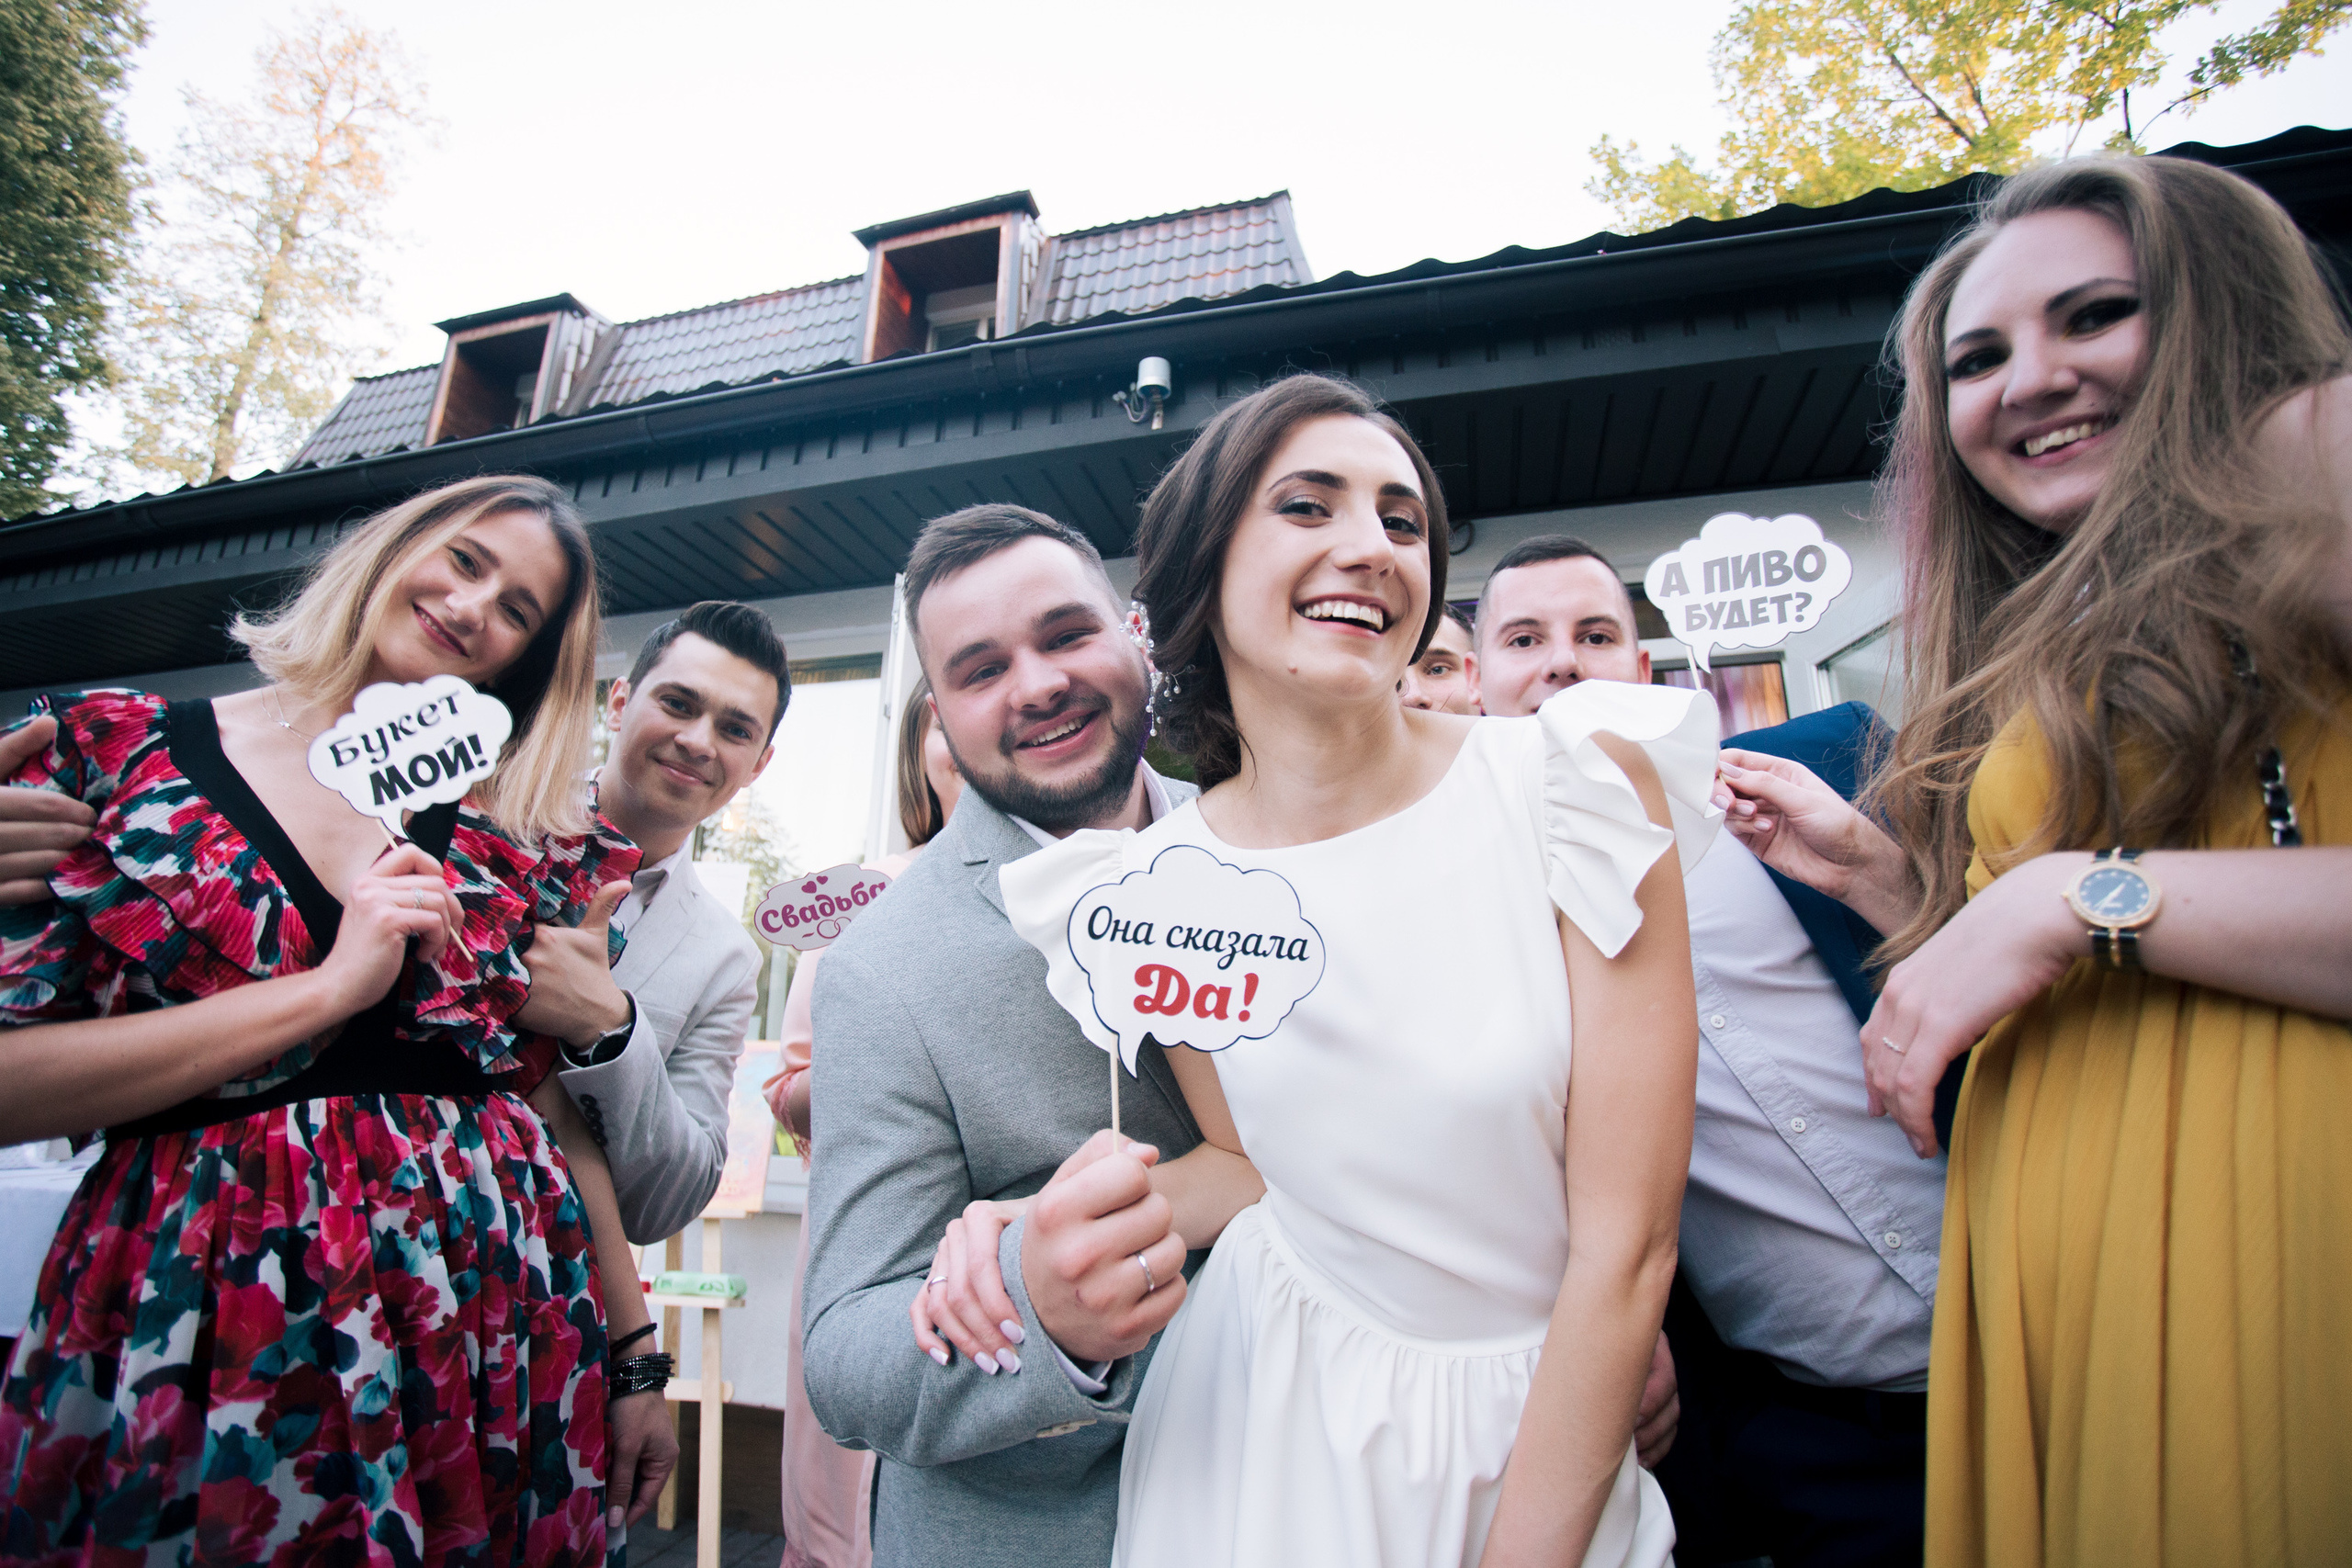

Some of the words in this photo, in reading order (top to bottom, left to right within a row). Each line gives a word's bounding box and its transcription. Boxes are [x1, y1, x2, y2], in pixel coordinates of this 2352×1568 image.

[1659, 561, 1690, 598] А
[1702, 545, 1827, 595] ПИВО
[1685, 592, 1813, 632] БУДЕТ?
[329, 690, 461, 767] Букет
[1088, 905, 1156, 946] Она
[1166, 925, 1310, 970] сказала
[1133, 964, 1260, 1022] Да!
